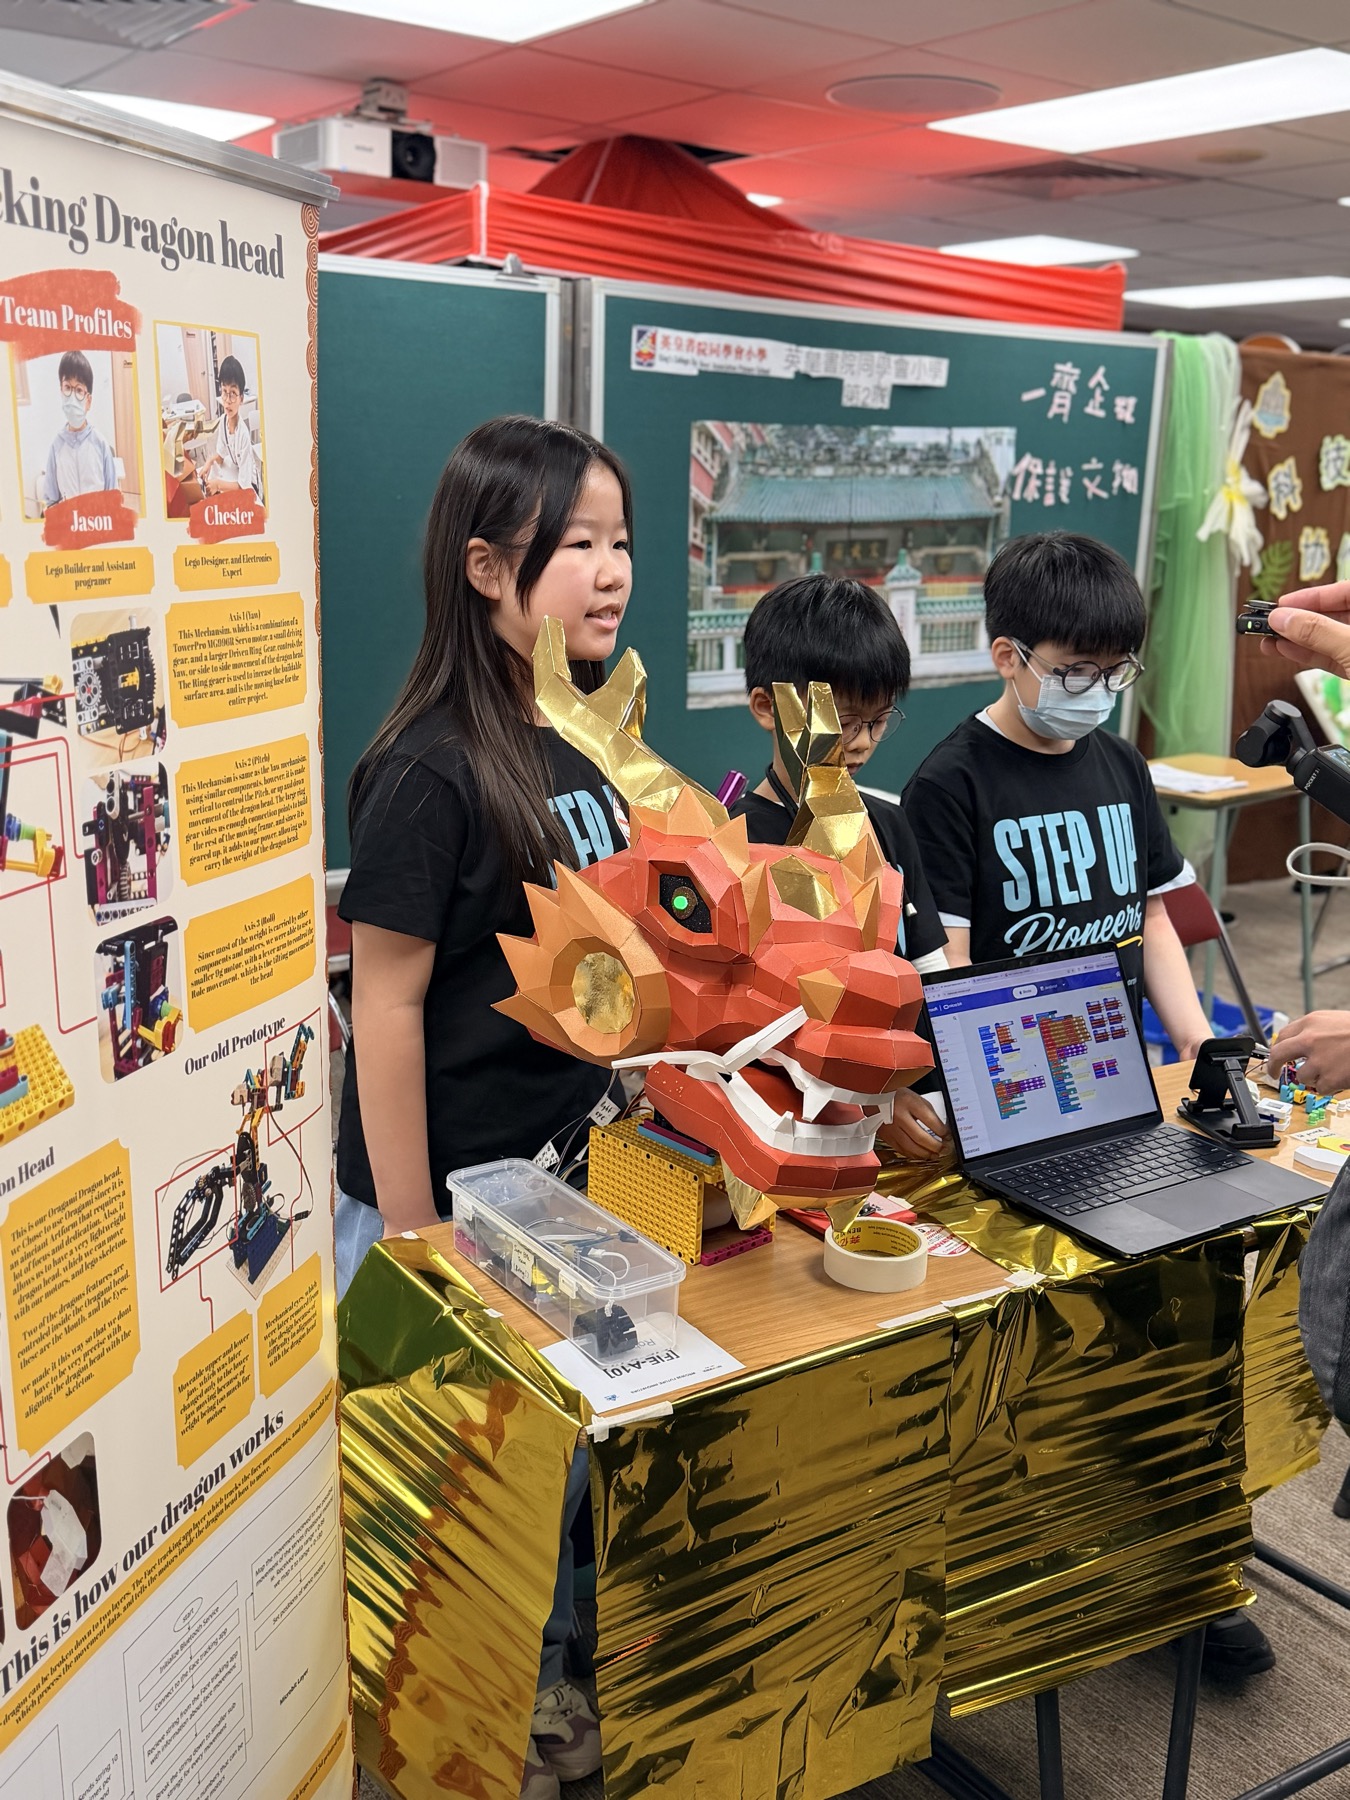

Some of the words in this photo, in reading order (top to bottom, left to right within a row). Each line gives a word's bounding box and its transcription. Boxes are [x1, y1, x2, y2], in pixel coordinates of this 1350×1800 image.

[0, 167, 89, 255] king
[93, 193, 216, 271] Dragon
[219, 220, 285, 279] head
[2, 296, 58, 330] Team
[61, 304, 133, 339] Profiles
[70, 510, 113, 533] Jason
[204, 506, 254, 526] Chester
[45, 564, 63, 577] Lego
[64, 563, 89, 574] Builder
[91, 562, 105, 571] and
[106, 560, 136, 571] Assistant
[184, 557, 200, 569] Lego
[230, 555, 241, 564] and
[222, 567, 243, 579] Expert
[75, 577, 112, 589] programer
[172, 641, 207, 653] TowerPro
[235, 636, 251, 645] Servo
[178, 629, 194, 640] This
[232, 622, 250, 633] which
[250, 622, 255, 632] is
[188, 668, 197, 676] or
[197, 664, 211, 674] side
[211, 664, 218, 673] to
[219, 661, 231, 671] side
[231, 658, 261, 670] movement
[190, 652, 203, 663] and
[209, 651, 228, 662] larger
[228, 648, 249, 658] Driven
[249, 646, 262, 656] Ring
[186, 793, 204, 805] using
[204, 788, 227, 800] similar
[188, 812, 221, 829] movement
[222, 809, 229, 820] of
[229, 808, 239, 818] the
[240, 803, 260, 815] dragon
[204, 861, 221, 871] carry
[222, 856, 233, 866] the
[233, 849, 253, 862] weight
[253, 845, 260, 856] of
[993, 810, 1096, 912] STEP
[1097, 803, 1137, 896] UP
[198, 950, 215, 962] Since
[216, 942, 231, 955] most
[231, 938, 239, 949] of
[239, 936, 248, 946] the
[249, 928, 268, 941] weight
[1004, 901, 1142, 957] Pioneers
[184, 1053, 210, 1076] Our
[210, 1037, 231, 1064] old
[231, 1017, 287, 1054] Prototype
[0, 1176, 16, 1197] on
[18, 1146, 55, 1185] Head
[10, 1245, 21, 1256] we
[22, 1230, 43, 1249] Chose
[43, 1225, 52, 1234] to
[52, 1217, 64, 1229] use
[94, 1187, 111, 1201] since
[112, 1181, 117, 1191] it
[118, 1178, 124, 1187] is
[11, 1227, 27, 1242] This
[27, 1222, 34, 1232] is
[34, 1214, 47, 1227] our
[78, 1179, 103, 1199] Dragon
[13, 1269, 23, 1282] lot
[23, 1260, 32, 1274] of
[32, 1253, 51, 1269] focus
[51, 1239, 64, 1256] and
[22, 1326, 38, 1341] Two
[38, 1316, 47, 1330] of
[46, 1311, 58, 1324] the
[58, 1292, 85, 1315] dragons
[86, 1273, 113, 1295] features
[113, 1263, 124, 1276] are
[34, 1381, 50, 1398] have
[50, 1375, 58, 1385] to
[58, 1368, 67, 1378] be
[67, 1357, 81, 1371] very
[602, 1349, 681, 1380] [FIE-A10]
[0, 1633, 49, 1697] This
[53, 1611, 71, 1643] is
[74, 1563, 118, 1621] how
[123, 1525, 158, 1572] our
[161, 1462, 226, 1535] dragon
[229, 1411, 283, 1469] works
[16, 1699, 36, 1724] which
[62, 1660, 73, 1675] the
[74, 1625, 106, 1663] movement
[28, 1682, 41, 1699] can
[41, 1673, 50, 1685] be
[50, 1648, 74, 1676] broken
[74, 1629, 90, 1651] down
[154, 1686, 174, 1711] Connect
